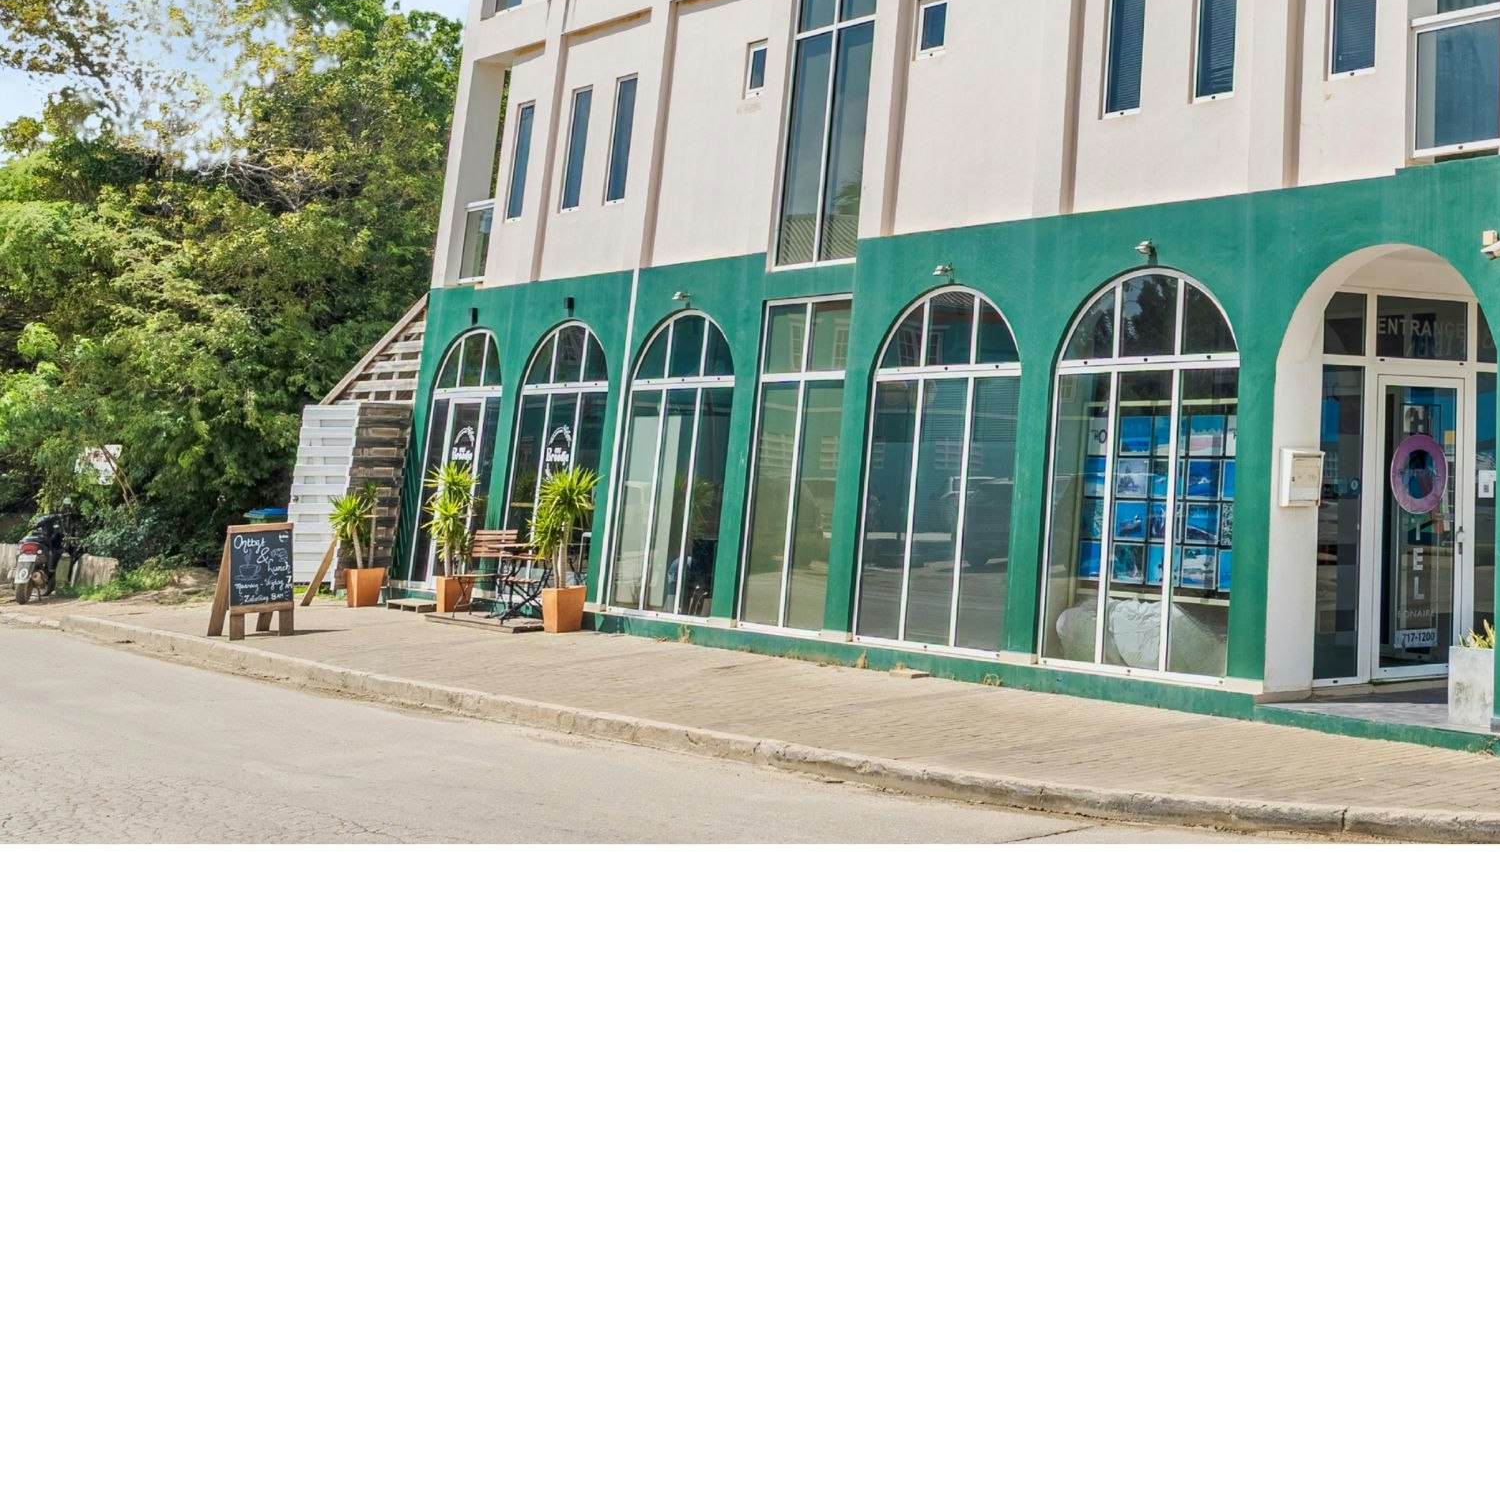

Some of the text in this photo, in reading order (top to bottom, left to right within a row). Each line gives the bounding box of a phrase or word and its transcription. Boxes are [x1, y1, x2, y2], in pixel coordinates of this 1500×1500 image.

[1377, 317, 1465, 338] ENTRANCE
[256, 546, 270, 564] &
[267, 558, 291, 576] Lunch
[1397, 609, 1435, 618] BONAIRE
[1402, 631, 1436, 643] 717-1200
